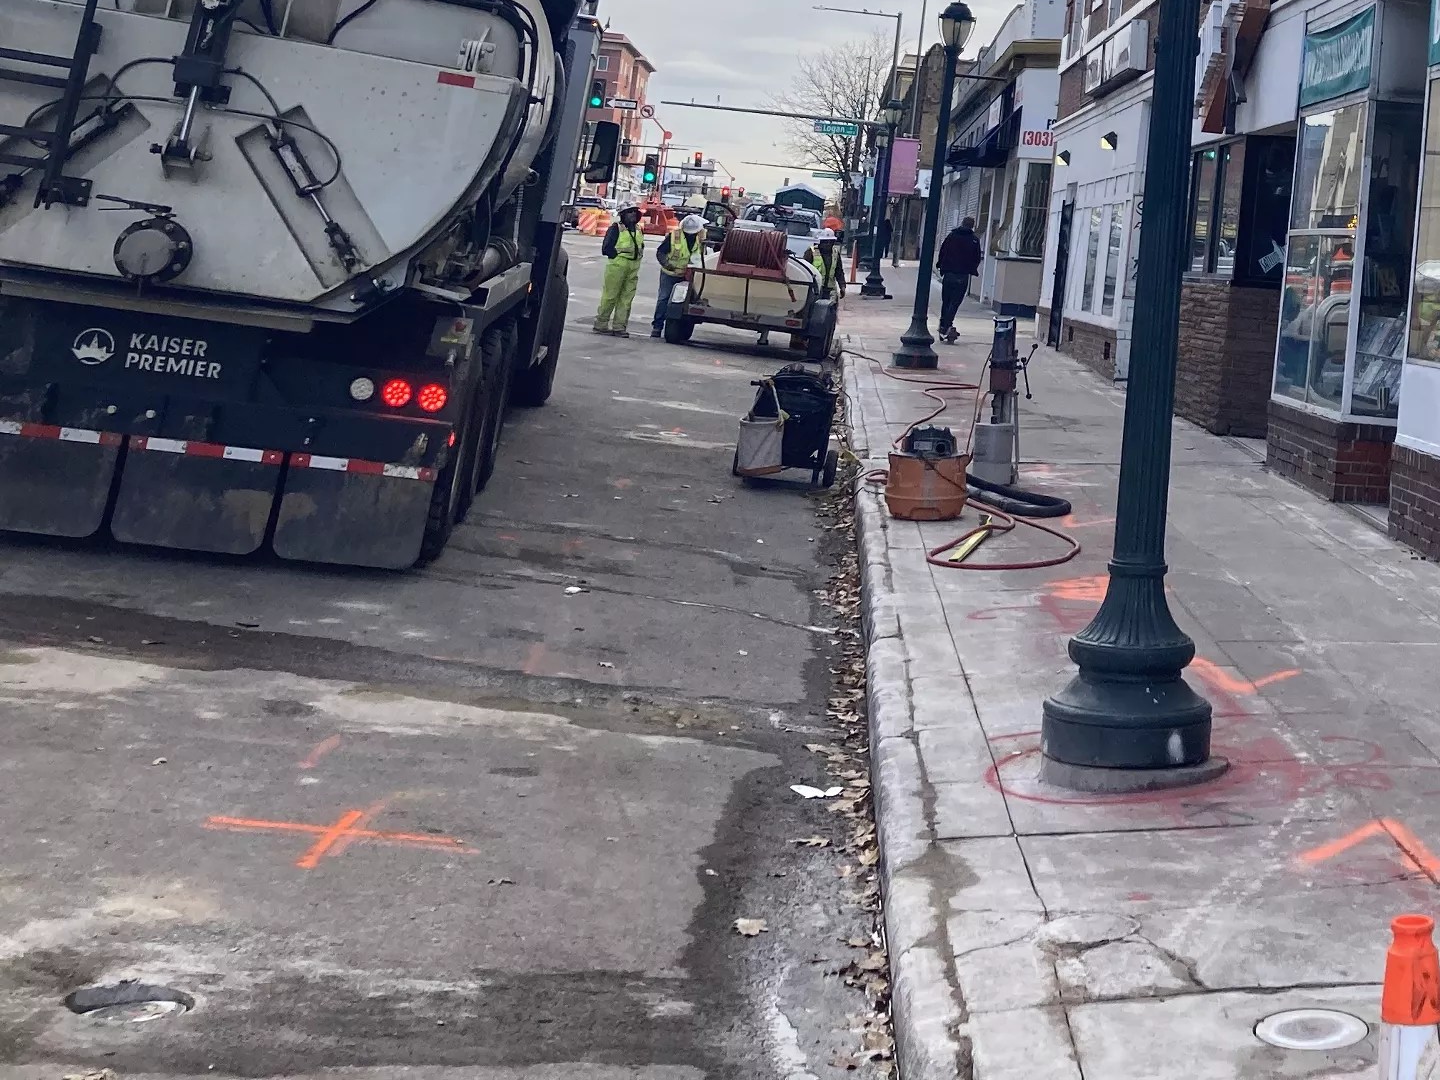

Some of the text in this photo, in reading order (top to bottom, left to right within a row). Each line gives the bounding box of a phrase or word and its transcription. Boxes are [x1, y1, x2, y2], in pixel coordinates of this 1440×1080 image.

[823, 124, 845, 133] Logan
[130, 333, 208, 357] KAISER
[125, 352, 221, 378] PREMIER
